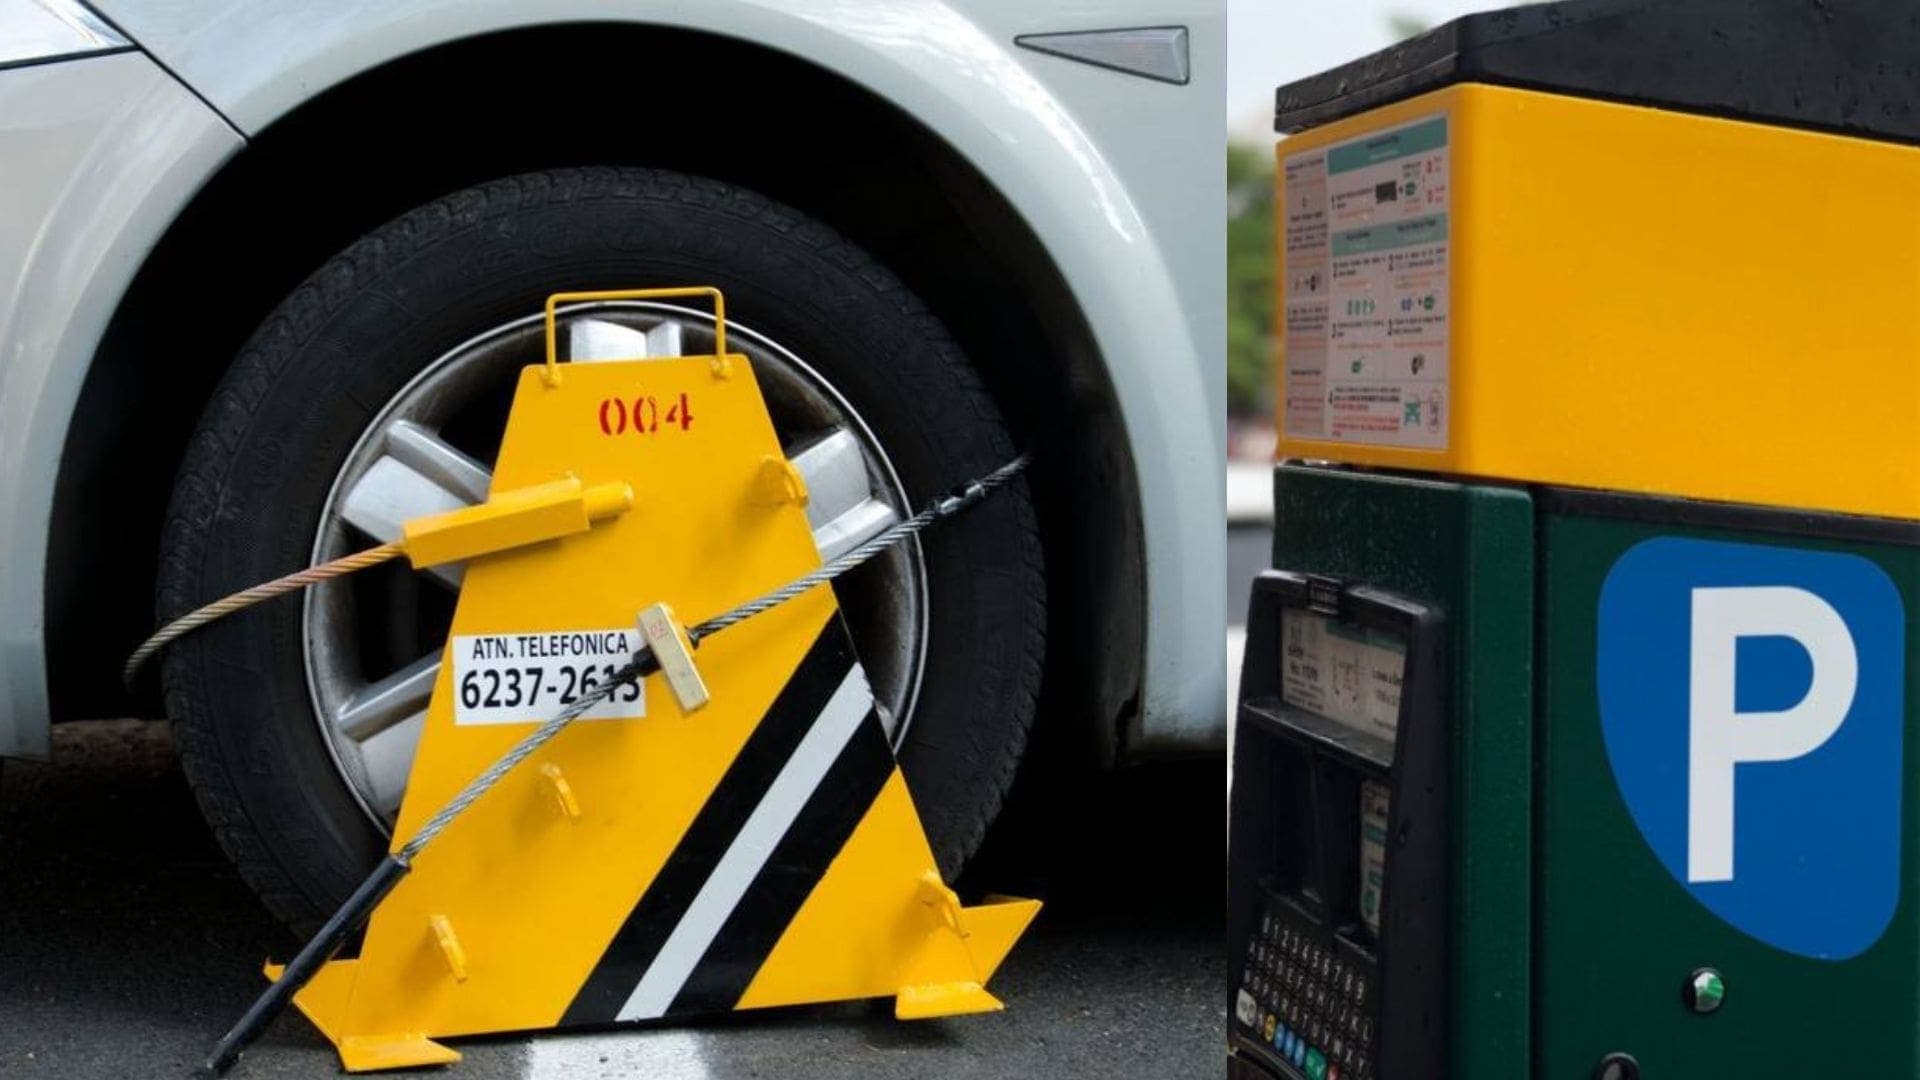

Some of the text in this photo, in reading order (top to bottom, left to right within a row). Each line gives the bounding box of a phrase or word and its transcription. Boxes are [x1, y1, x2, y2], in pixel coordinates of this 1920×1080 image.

[599, 393, 694, 435] 004
[472, 632, 629, 660] ATN. TELEFONICA
[1688, 585, 1859, 884] P
